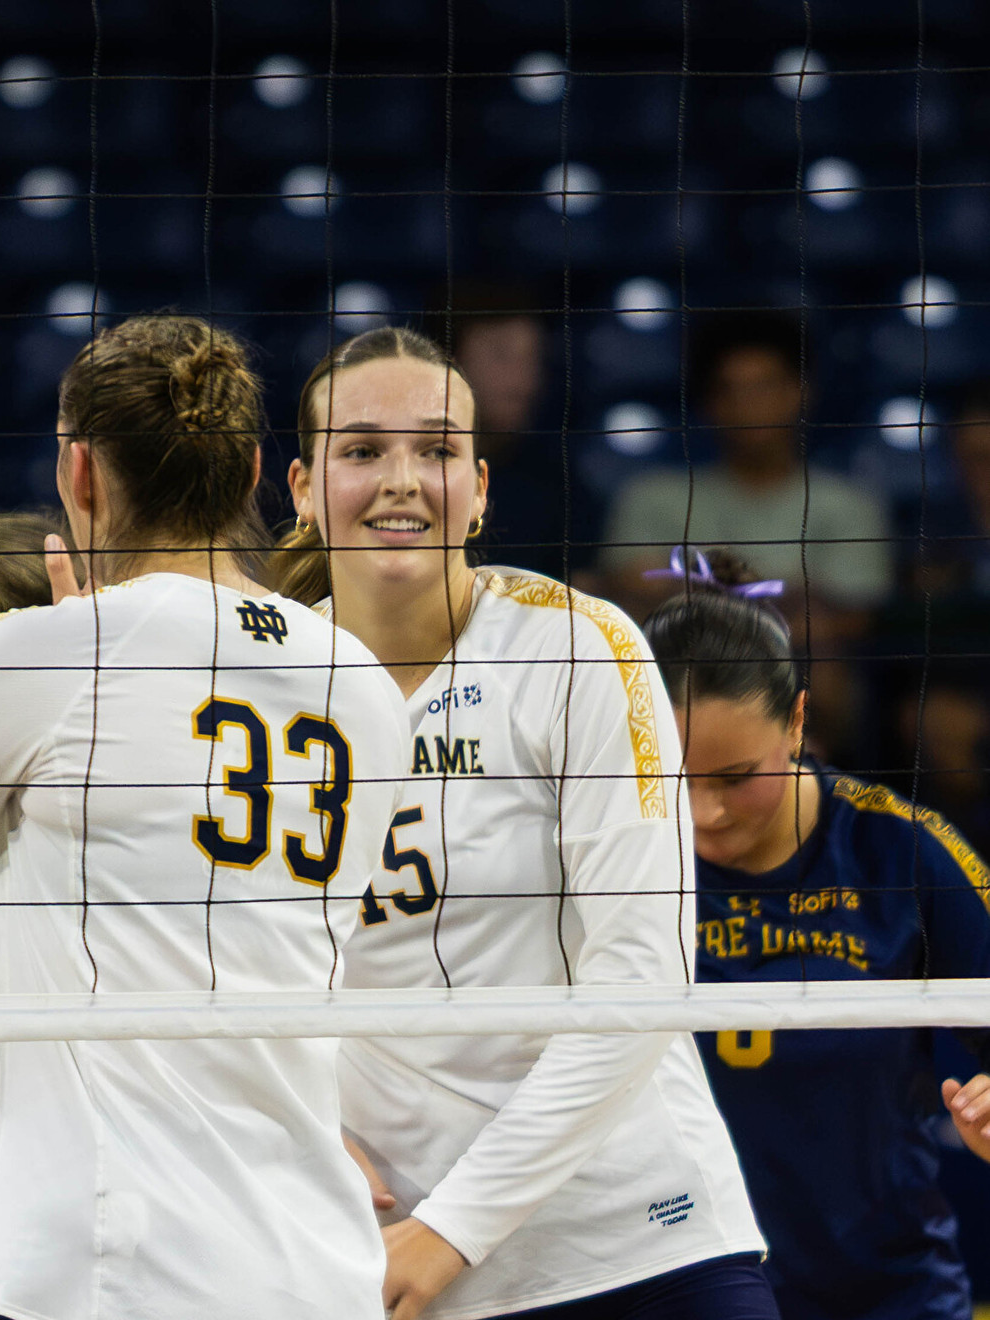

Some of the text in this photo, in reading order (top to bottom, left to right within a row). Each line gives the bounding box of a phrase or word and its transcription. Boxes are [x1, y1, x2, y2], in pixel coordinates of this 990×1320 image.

[428, 687, 459, 714] oFi
[411, 735, 484, 775] AME
[191, 695, 353, 887] 33
